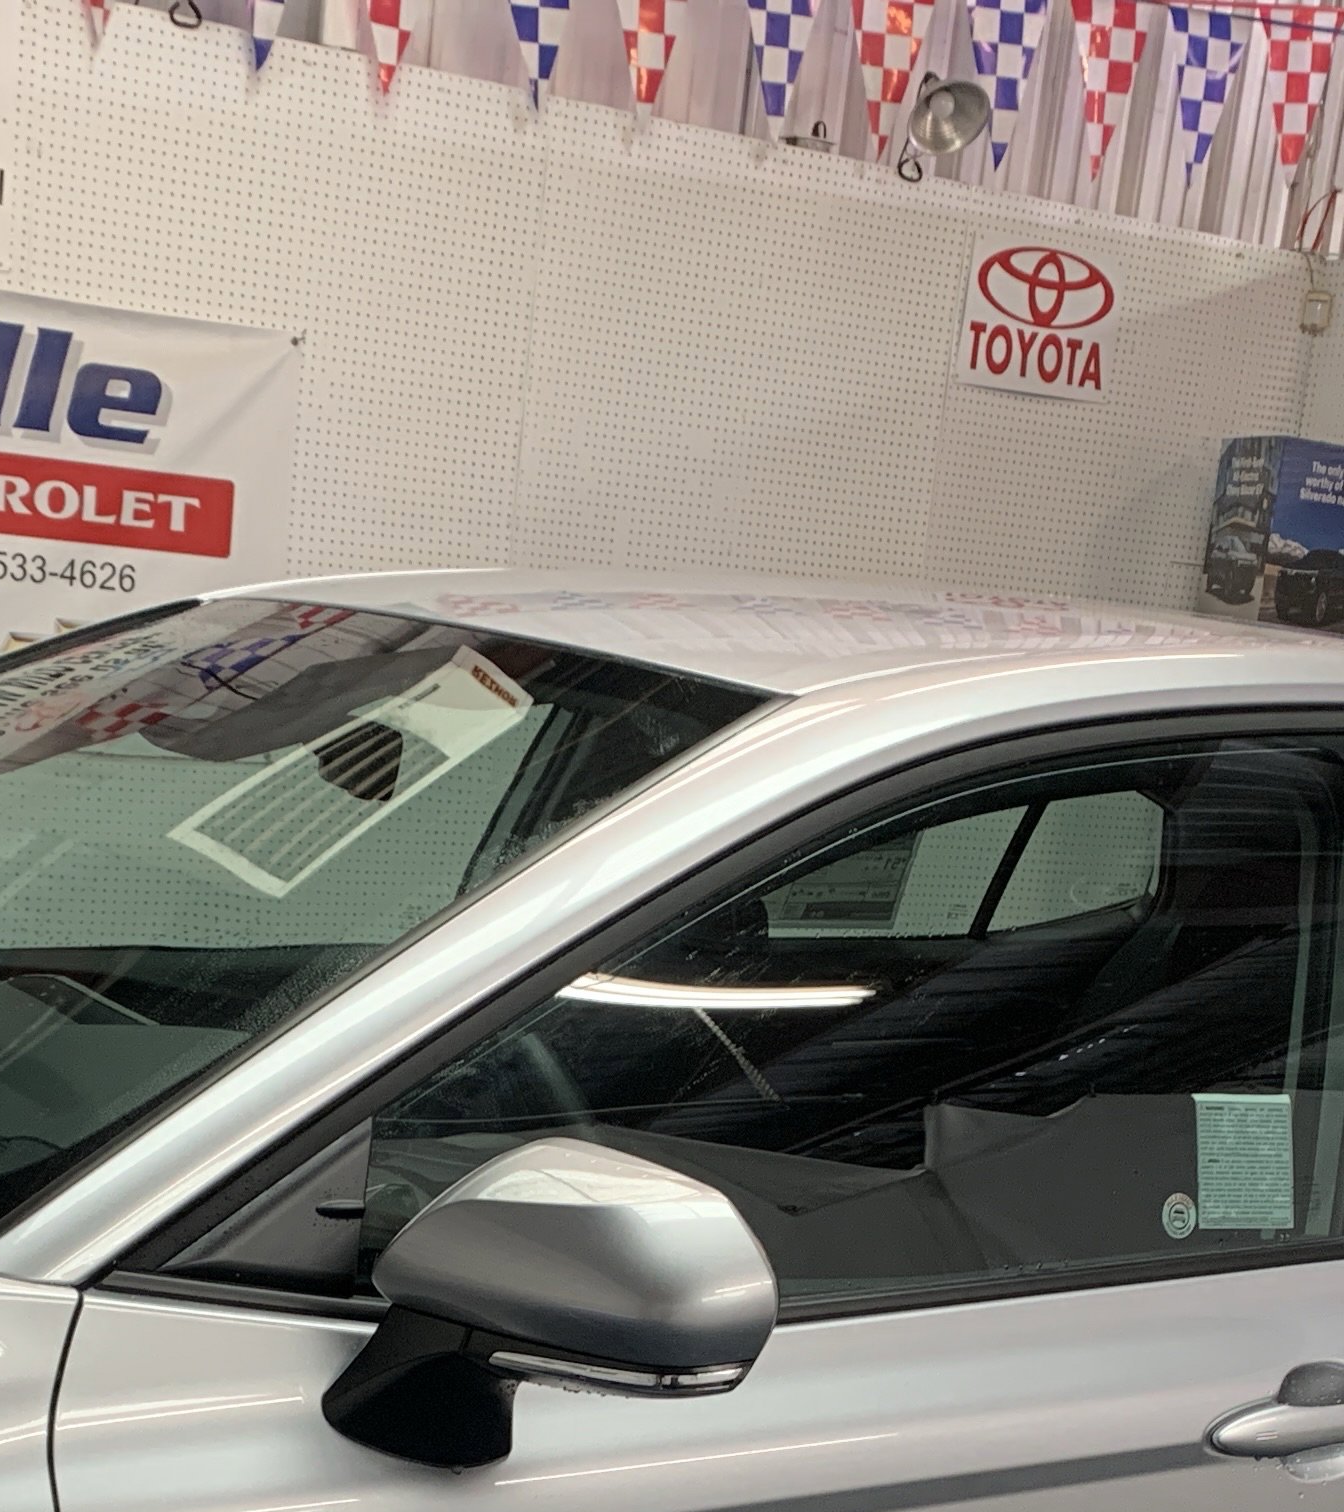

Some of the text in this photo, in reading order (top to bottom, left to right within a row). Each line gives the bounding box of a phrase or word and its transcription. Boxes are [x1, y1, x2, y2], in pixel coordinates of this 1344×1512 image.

[969, 320, 1102, 391] TOYOTA
[1312, 461, 1326, 474] The
[1328, 464, 1344, 479] only
[1305, 477, 1334, 491] worthy
